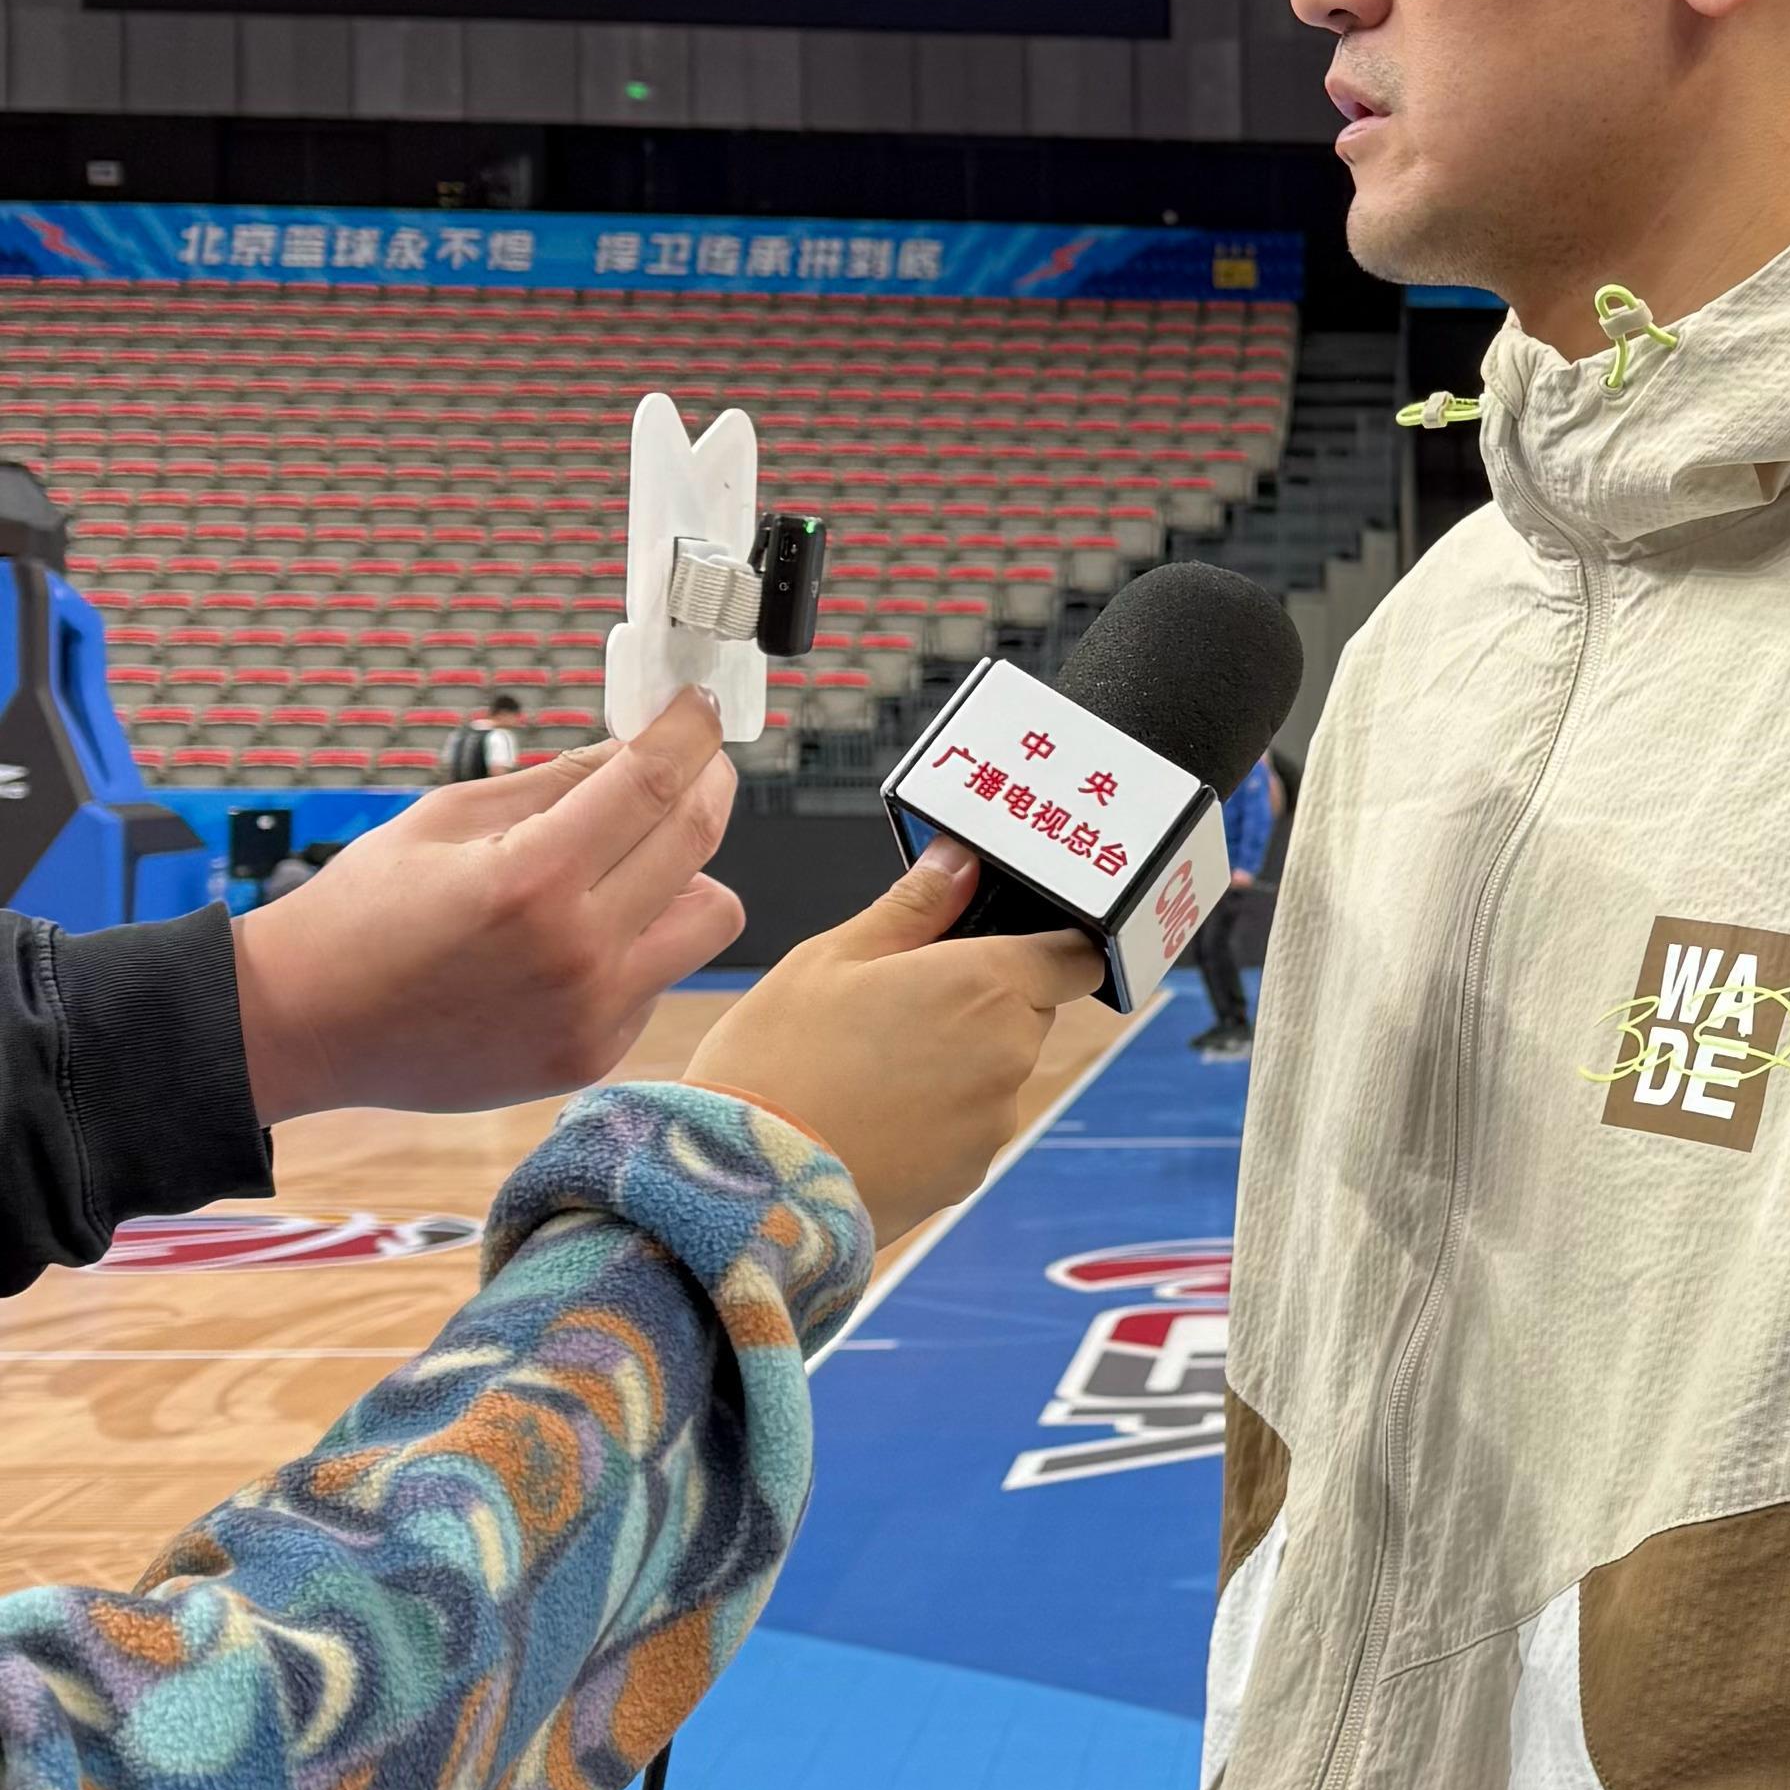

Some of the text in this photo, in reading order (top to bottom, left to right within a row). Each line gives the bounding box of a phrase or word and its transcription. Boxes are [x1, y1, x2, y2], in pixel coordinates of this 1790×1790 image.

[931, 744, 1130, 877] 广播电视总台
[1018, 730, 1120, 807] 中央
[1155, 859, 1200, 961] CMG
